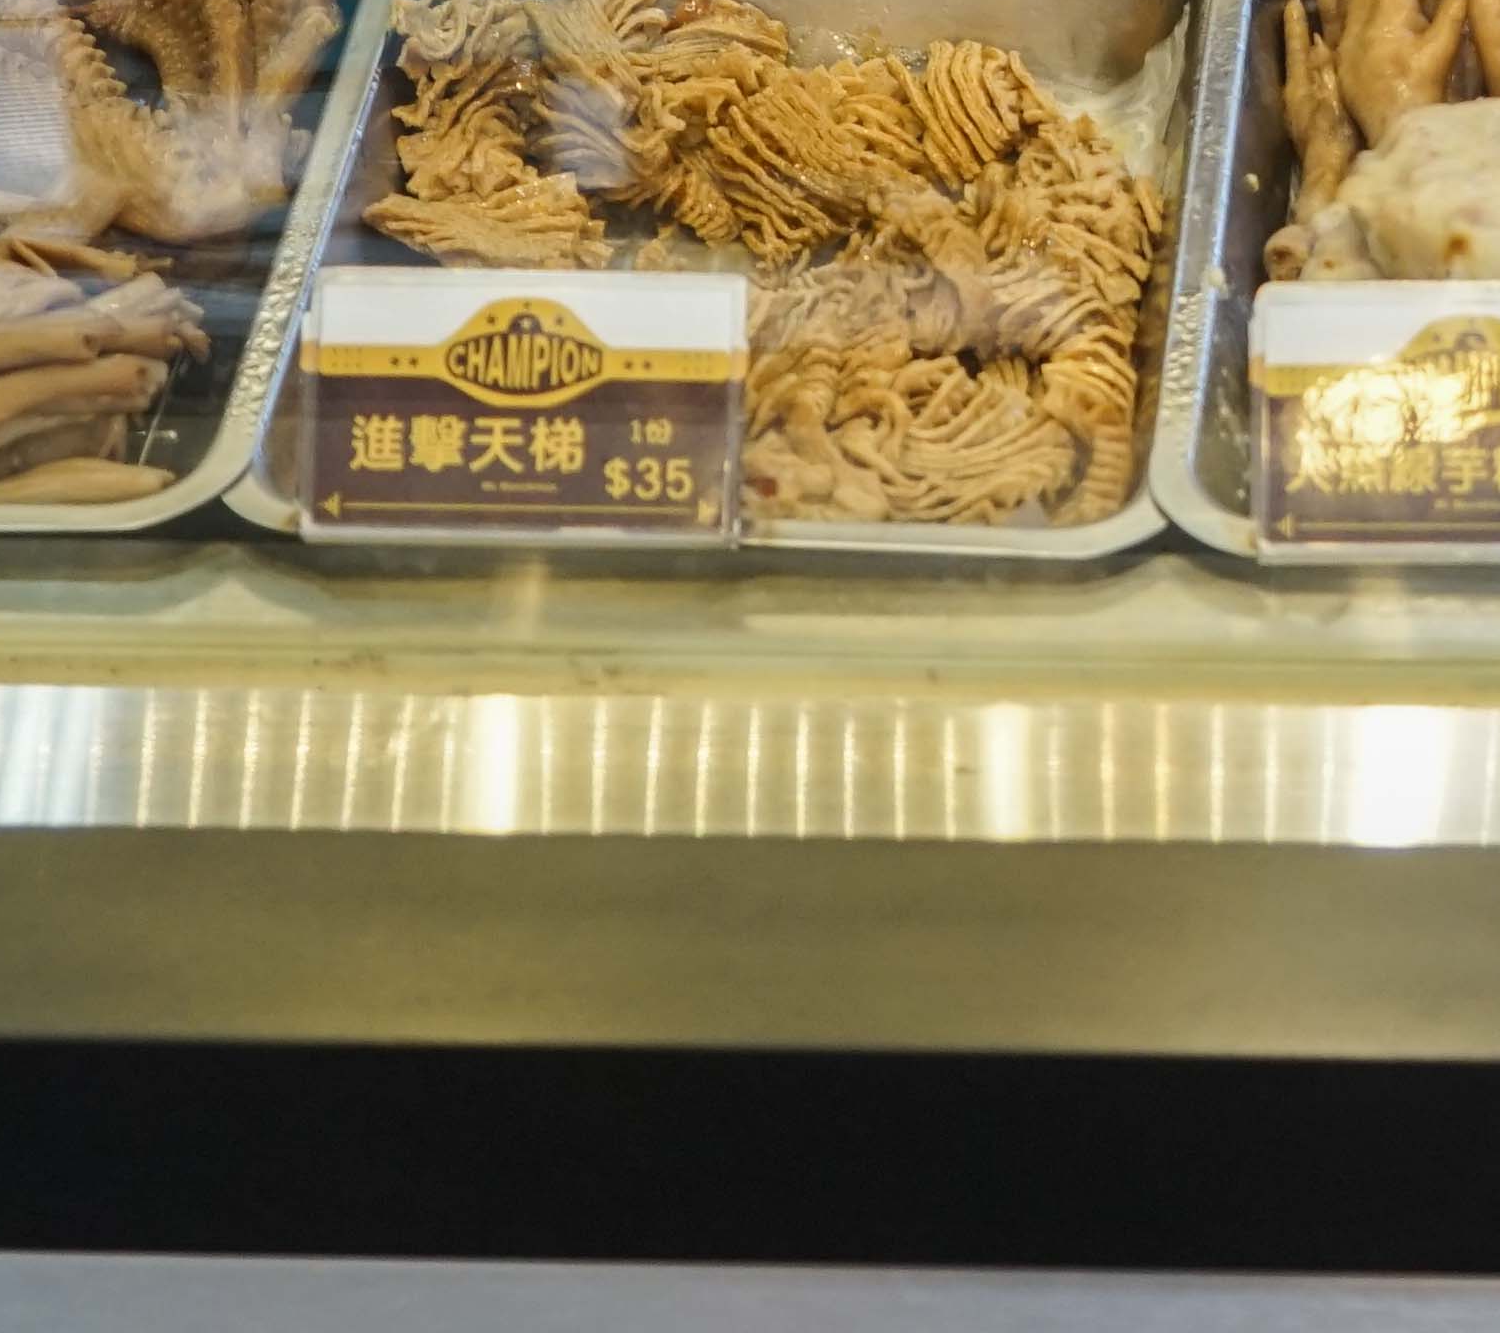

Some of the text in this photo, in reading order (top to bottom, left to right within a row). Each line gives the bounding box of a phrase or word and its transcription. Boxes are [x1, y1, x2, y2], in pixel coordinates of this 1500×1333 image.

[449, 334, 601, 391] CHAMPION
[349, 413, 586, 475] 進擊天梯
[602, 456, 695, 502] $35
